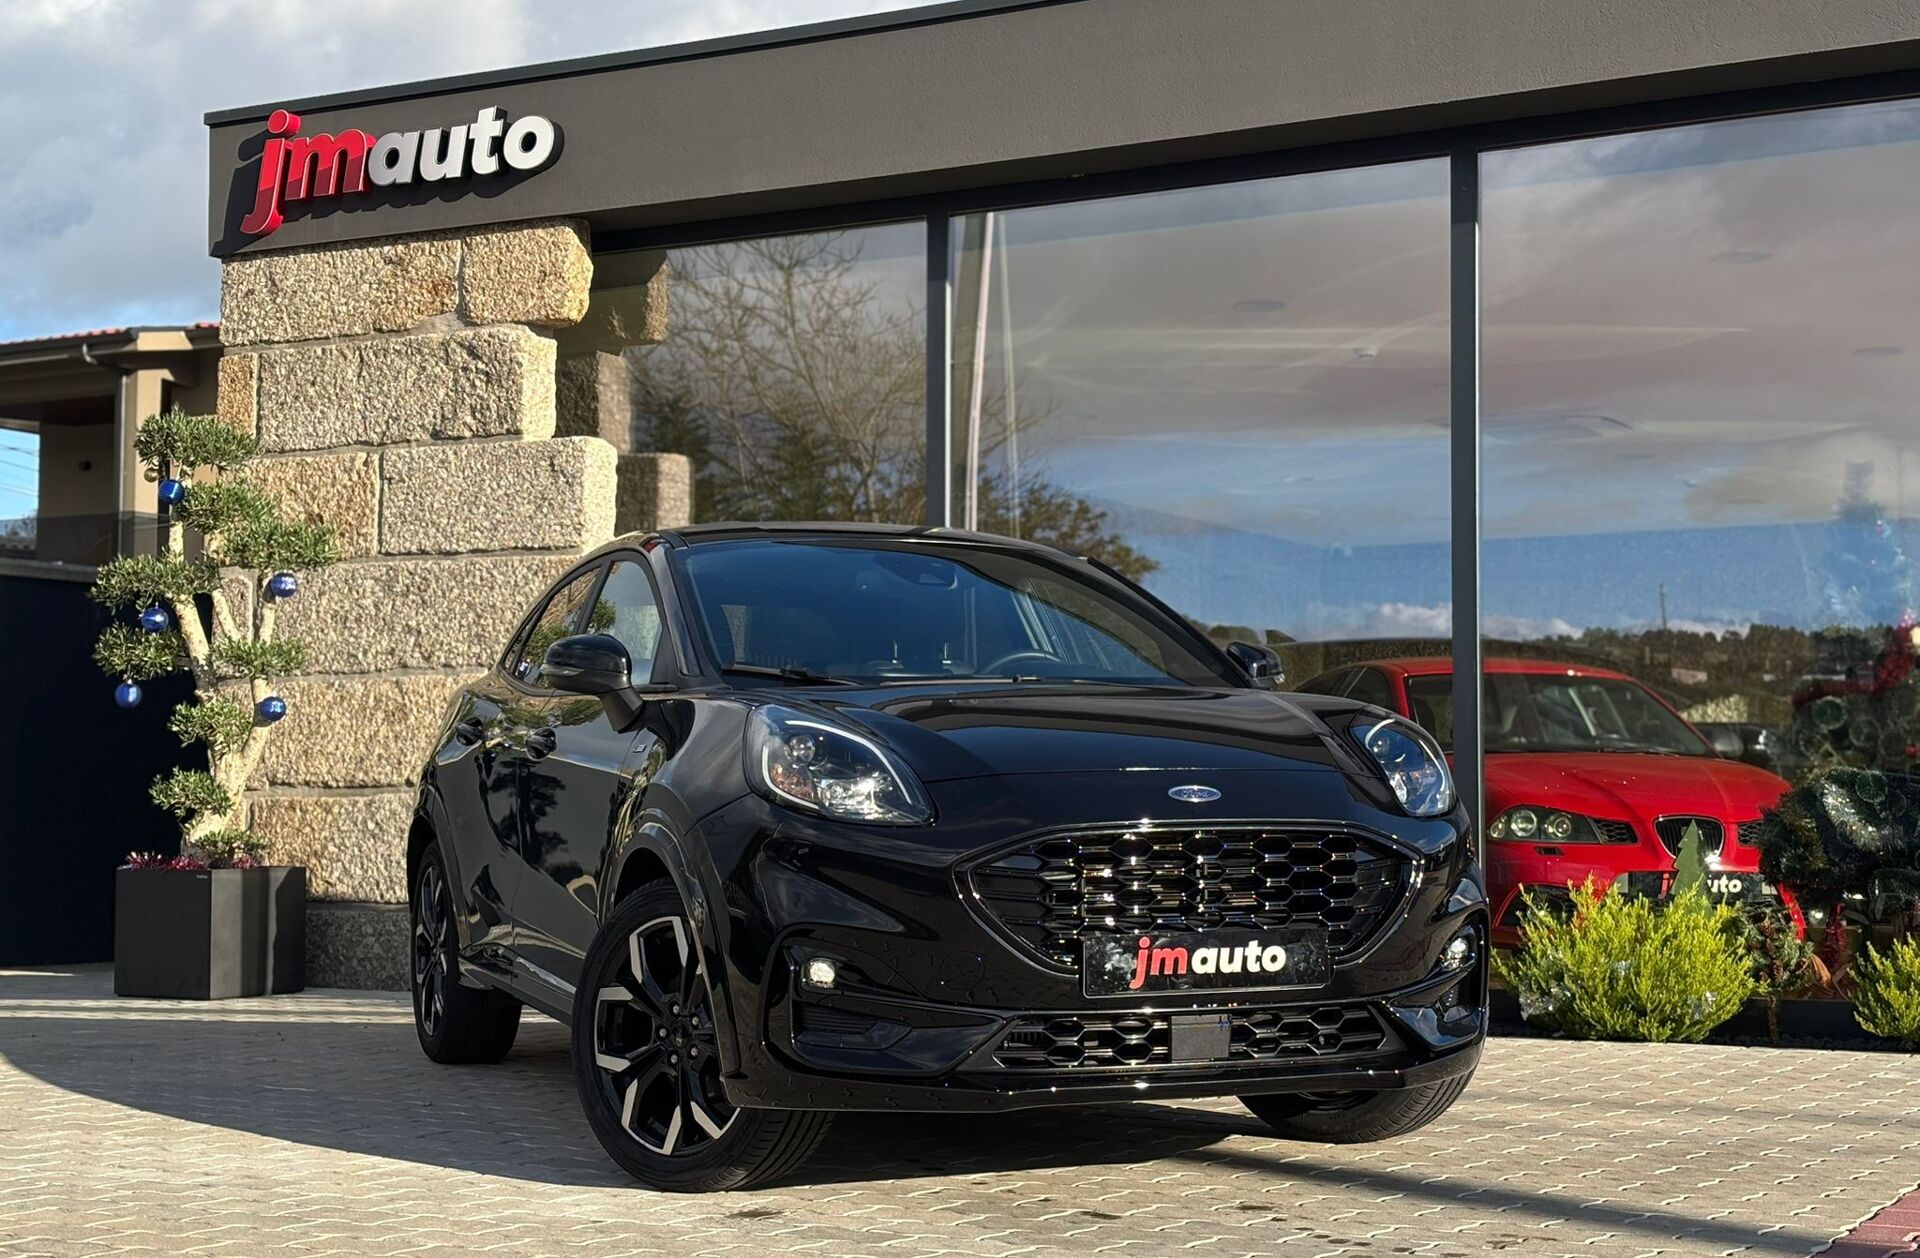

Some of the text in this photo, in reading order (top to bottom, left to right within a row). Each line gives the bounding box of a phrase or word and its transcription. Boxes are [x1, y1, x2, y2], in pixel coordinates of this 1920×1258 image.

[240, 105, 558, 234] jmauto
[1657, 872, 1743, 900] juto
[1128, 936, 1287, 989] jmauto
